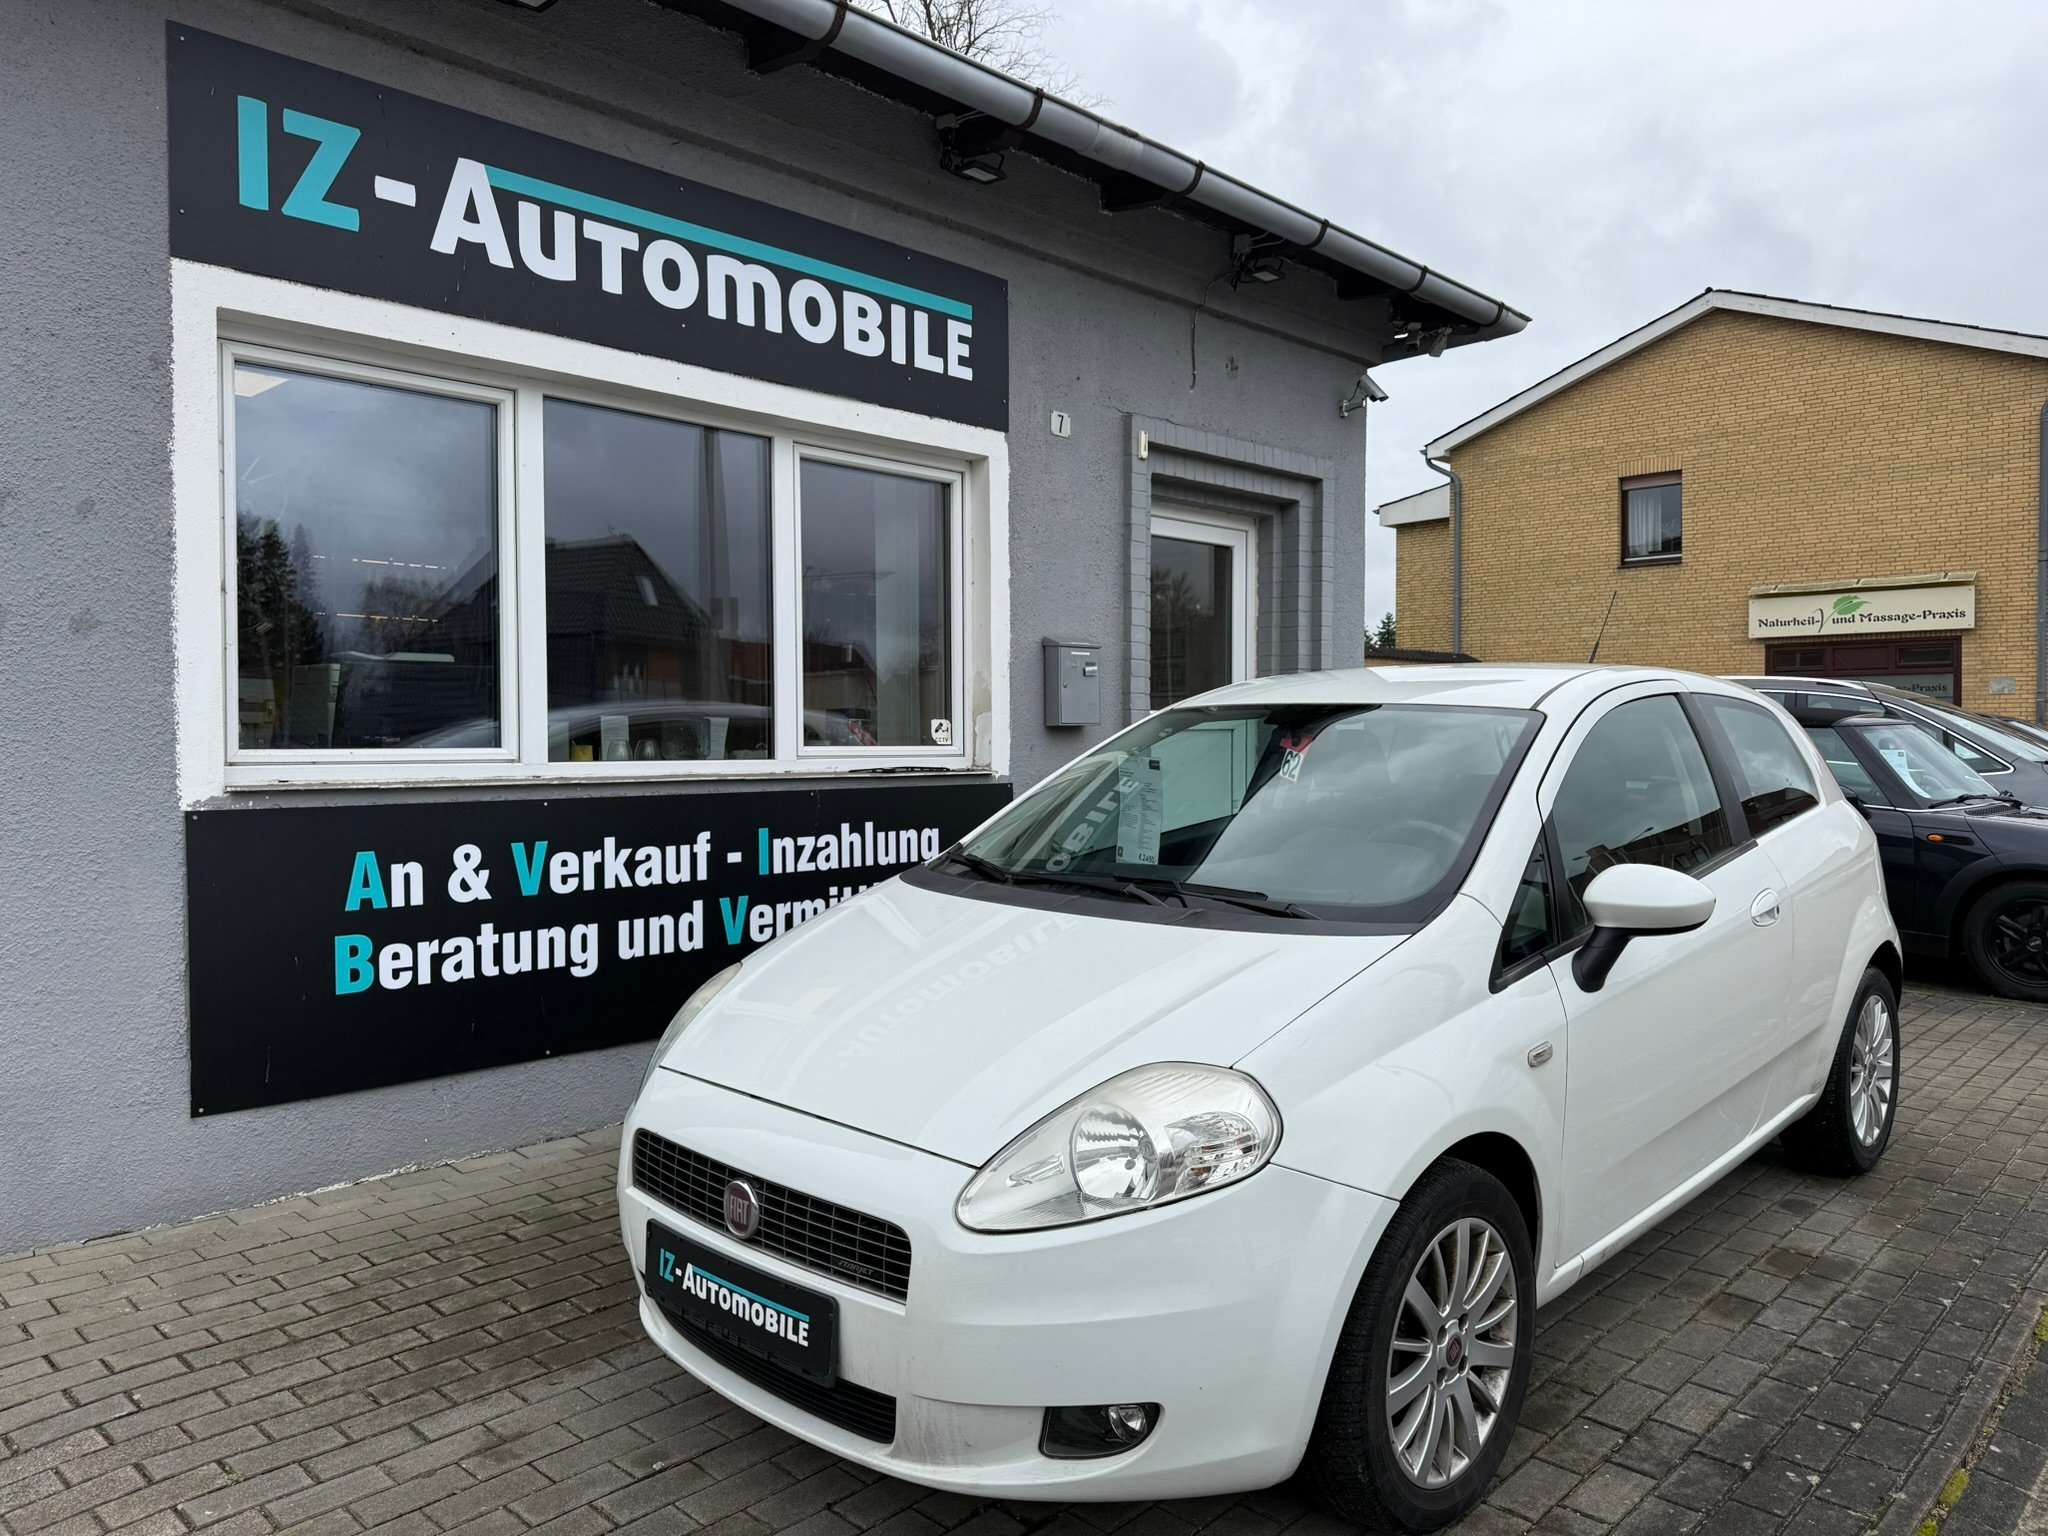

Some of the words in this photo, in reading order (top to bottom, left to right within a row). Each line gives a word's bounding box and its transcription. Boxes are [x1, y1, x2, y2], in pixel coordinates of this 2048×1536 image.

[1057, 414, 1065, 434] 7
[1832, 613, 1856, 625] und
[1859, 607, 1966, 625] Massage-Praxis
[345, 851, 424, 912] An
[448, 843, 493, 903] &
[511, 831, 711, 897] Verkauf
[758, 821, 940, 875] Inzahlung
[335, 922, 599, 995] Beratung
[619, 900, 704, 960] und
[729, 1195, 750, 1226] FIAT
